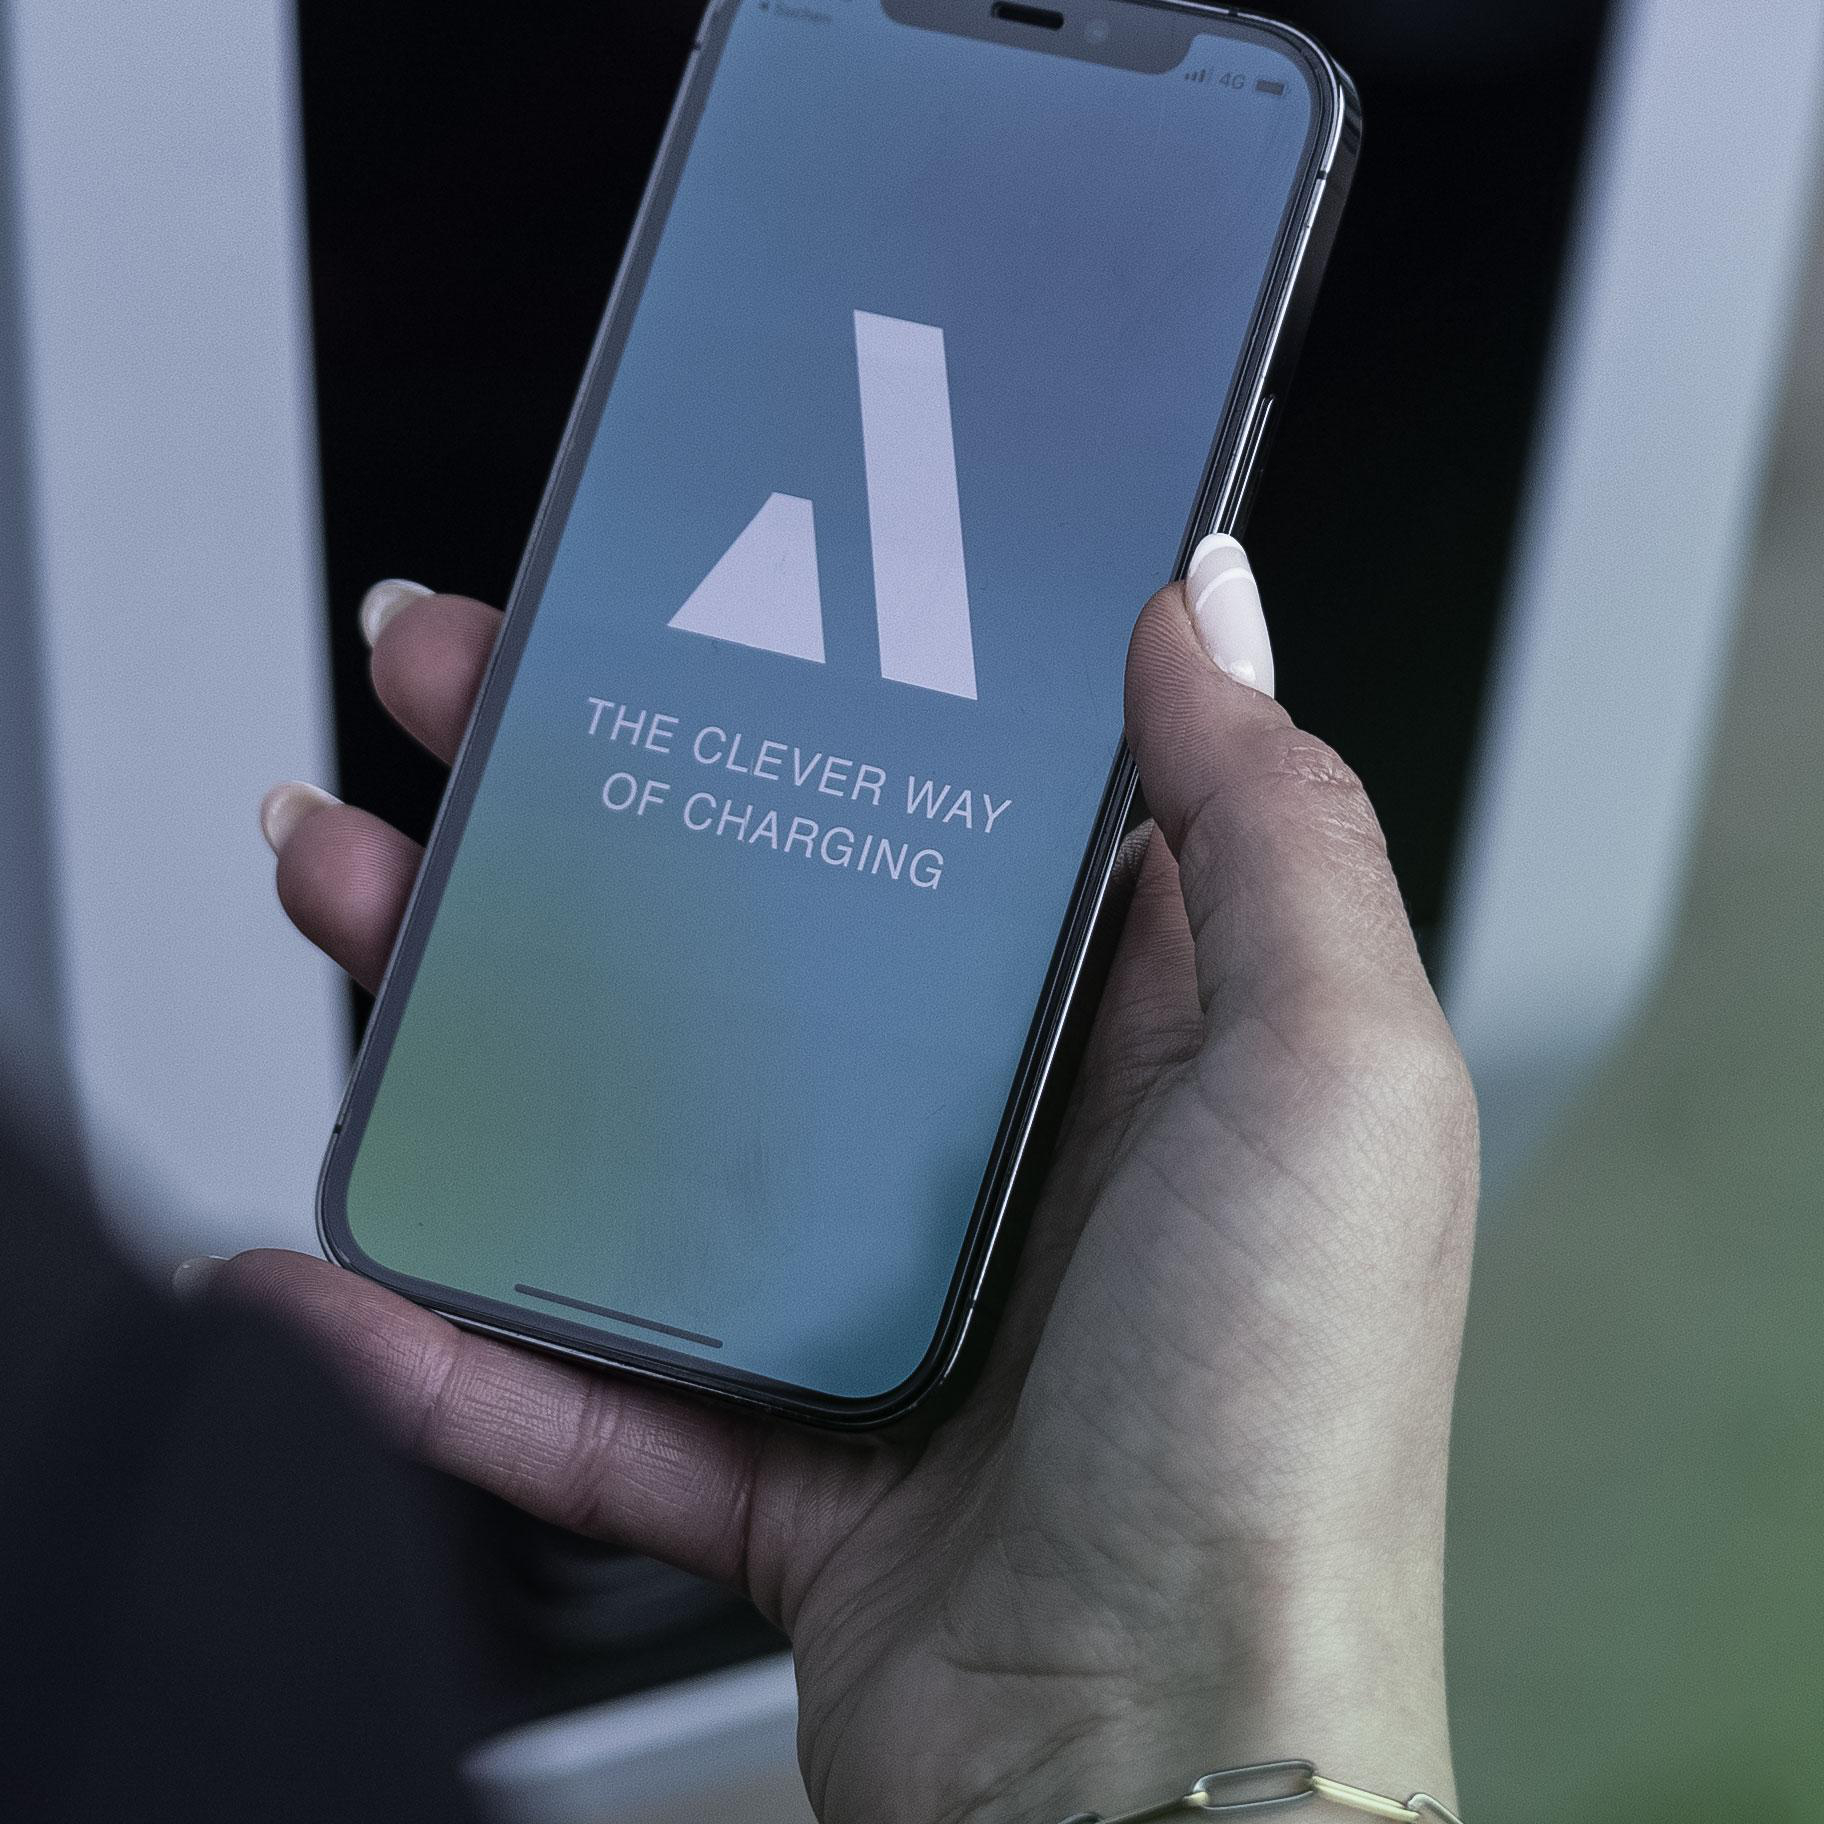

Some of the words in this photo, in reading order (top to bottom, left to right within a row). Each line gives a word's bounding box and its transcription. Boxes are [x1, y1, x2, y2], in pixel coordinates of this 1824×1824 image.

[1219, 72, 1246, 90] 4G
[587, 697, 679, 754] THE
[693, 726, 887, 806] CLEVER
[906, 776, 1013, 834] WAY
[601, 772, 670, 816] OF
[682, 792, 945, 890] CHARGING
